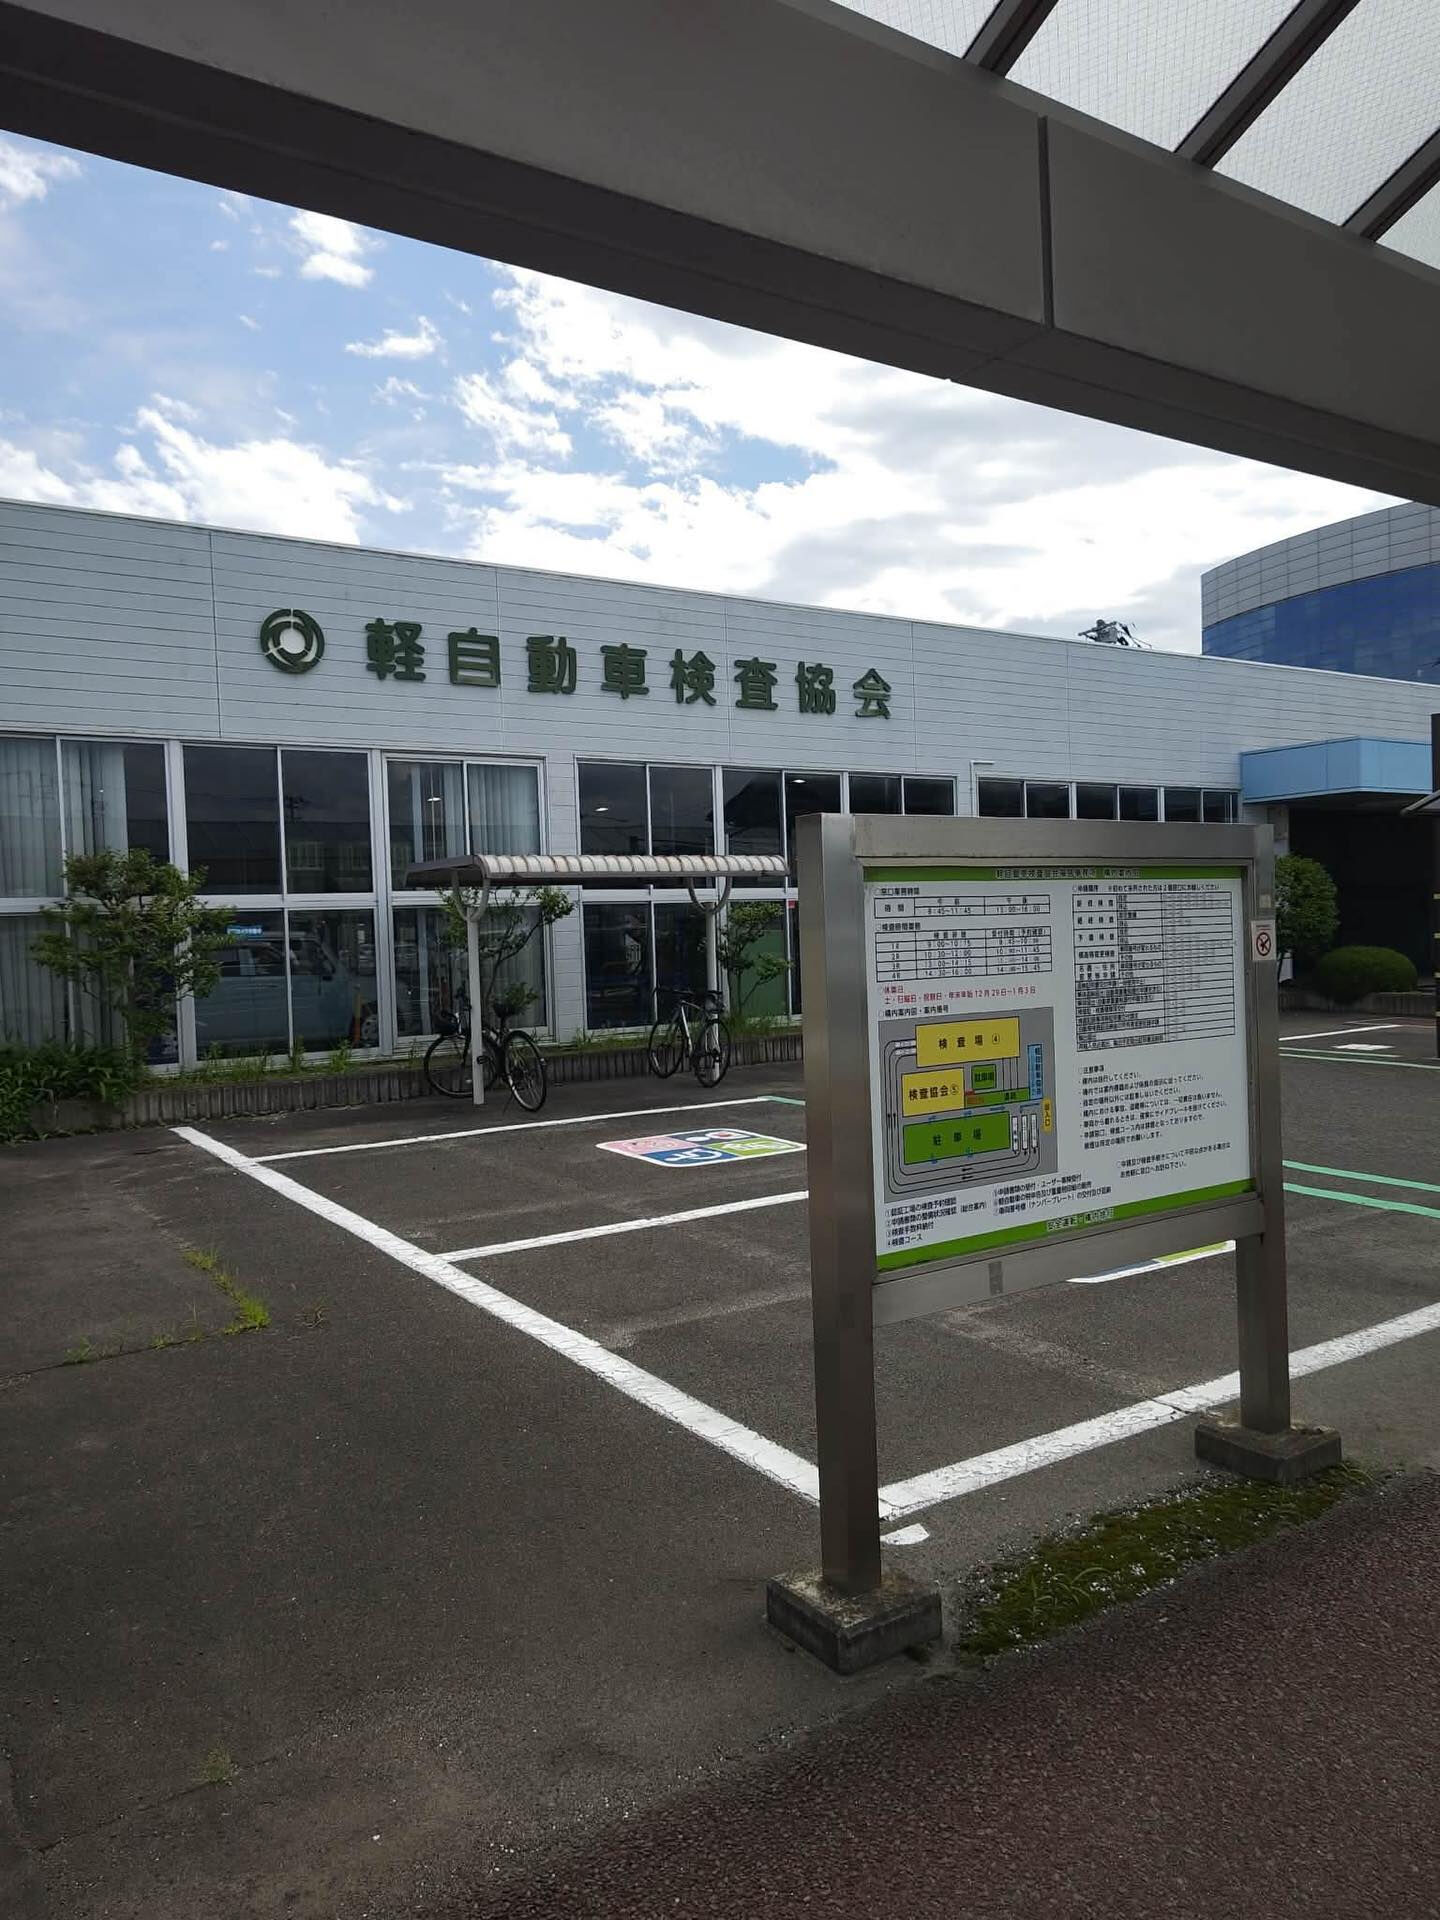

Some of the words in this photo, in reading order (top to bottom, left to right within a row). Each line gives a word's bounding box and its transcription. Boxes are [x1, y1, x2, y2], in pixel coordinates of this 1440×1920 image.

[365, 617, 892, 719] 軽自動車検査協会
